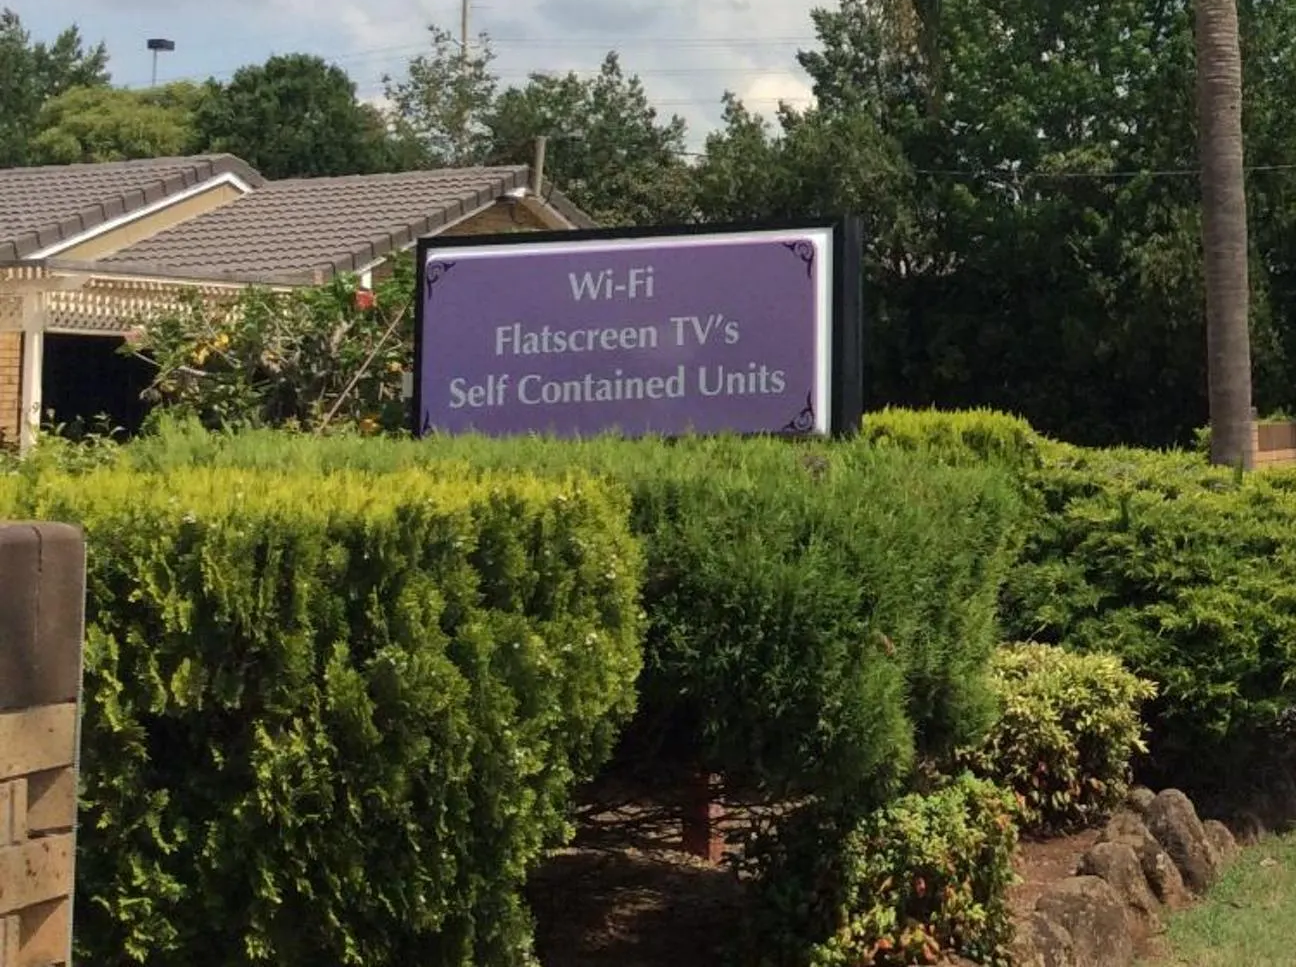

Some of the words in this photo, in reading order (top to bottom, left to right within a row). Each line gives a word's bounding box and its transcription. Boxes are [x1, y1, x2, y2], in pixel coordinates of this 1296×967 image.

[568, 265, 655, 301] Wi-Fi
[496, 322, 658, 356] Flatscreen
[670, 313, 740, 347] TV's
[449, 374, 511, 409] Self
[517, 364, 685, 406] Contained
[699, 362, 788, 396] Units
